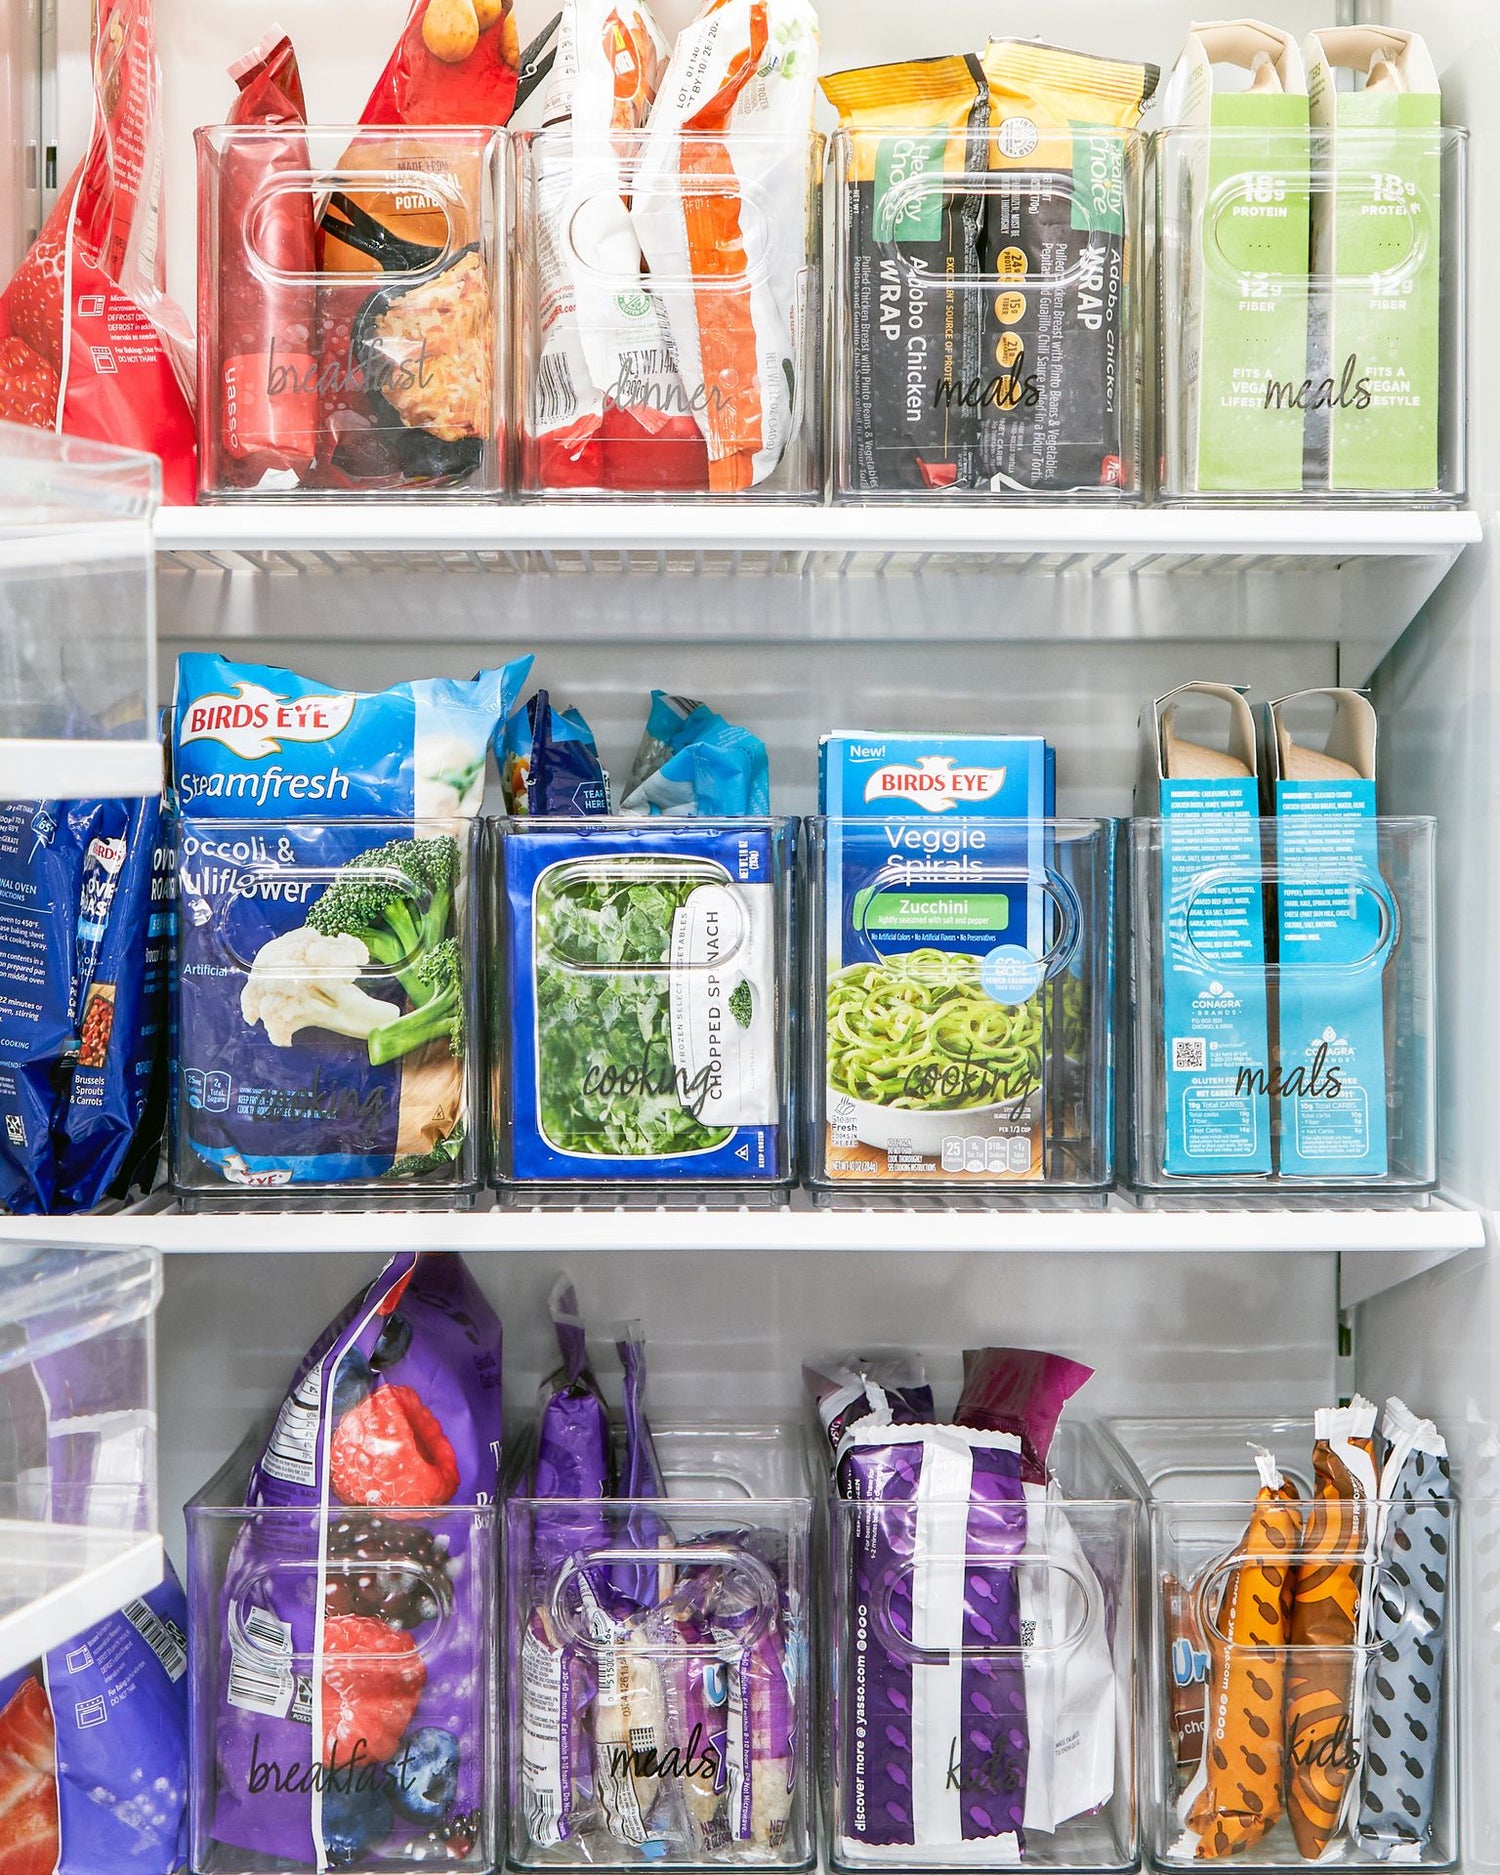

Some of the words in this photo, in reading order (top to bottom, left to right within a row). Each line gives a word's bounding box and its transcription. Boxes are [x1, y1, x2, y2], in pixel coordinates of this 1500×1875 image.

[1232, 206, 1287, 217] PROTEIN
[861, 255, 872, 285] Pulled
[1054, 243, 1068, 272] Pulled
[1077, 246, 1107, 330] WRAP
[1105, 248, 1121, 321] Adobo
[861, 286, 872, 321] Chicken
[879, 260, 901, 340] WRAP
[1238, 301, 1276, 312] FIBER
[1369, 299, 1407, 310] FIBER
[945, 305, 954, 340] SOURCE
[1037, 297, 1052, 332] Guajillo
[1052, 310, 1066, 339] Breast
[861, 323, 872, 352] Breast
[945, 341, 953, 354] OF
[1037, 334, 1050, 355] Chili
[861, 354, 871, 374] with
[1051, 341, 1064, 363] with
[266, 336, 434, 397] breakfast
[907, 336, 928, 422] Chicken
[1036, 356, 1050, 383] Sauce
[1050, 364, 1063, 389] Pinto
[1105, 329, 1116, 413] Chicken
[1233, 368, 1260, 379] FITS
[1263, 367, 1273, 379] A
[1365, 367, 1391, 378] FITS
[1396, 367, 1405, 377] A
[602, 357, 731, 413] dinner
[862, 377, 872, 401] Pinto
[933, 351, 1041, 408] meals
[1264, 353, 1371, 410] meals
[225, 367, 238, 449] yasso
[863, 402, 873, 430] Beans
[1049, 390, 1061, 418] Beans
[865, 431, 874, 439] &
[1032, 432, 1046, 455] Flour
[191, 703, 269, 732] BIRDS
[276, 703, 330, 729] EYE
[849, 744, 887, 758] New!
[180, 765, 351, 807] Steamfresh
[881, 774, 946, 791] BIRDS
[951, 774, 989, 791] EYE
[585, 799, 606, 809] HERE
[277, 833, 296, 862] &
[883, 825, 986, 854] Veggie
[886, 854, 984, 886] Spirals
[14, 881, 37, 895] OVEN
[899, 899, 969, 915] Zucchini
[9, 936, 31, 948] cooking
[6, 962, 34, 972] prepared
[33, 968, 46, 976] pan
[7, 953, 33, 963] contents
[183, 962, 229, 977] Artificial
[7, 972, 28, 982] middle
[28, 977, 45, 985] oven
[7, 998, 35, 1009] minutes
[675, 982, 684, 1020] SELECT
[1192, 1000, 1241, 1010] CONAGRA
[15, 1010, 40, 1022] stirring
[0, 1038, 30, 1050] COOKING
[676, 1024, 687, 1063] FROZEN
[708, 1007, 722, 1101] CHOPPED
[75, 1074, 105, 1086] Brussels
[583, 1041, 714, 1116] cooking
[903, 1041, 1038, 1121] cooking
[1192, 1076, 1222, 1085] GLUTEN
[1235, 1042, 1342, 1099] meals
[75, 1085, 104, 1097] Sprouts
[76, 1095, 103, 1107] Carrots
[206, 1095, 226, 1104] Sugars
[209, 1088, 226, 1097] Total
[831, 1123, 858, 1132] Fresh
[946, 1142, 961, 1156] 25
[866, 1480, 874, 1497] thaw
[863, 1525, 871, 1539] best
[870, 1524, 878, 1549] minutes
[855, 1655, 867, 1726] yasso.com
[561, 1692, 569, 1721] minutes.
[560, 1723, 568, 1735] Eat
[855, 1727, 866, 1738] @
[1286, 1711, 1361, 1769] kids
[560, 1735, 569, 1755] within
[609, 1721, 719, 1781] meals
[248, 1733, 416, 1794] breakfast
[561, 1755, 569, 1770] 8-10
[856, 1741, 865, 1775] more
[945, 1736, 1023, 1792] kids
[742, 1782, 750, 1795] Not
[741, 1794, 749, 1833] Microwave.
[855, 1777, 866, 1831] discover
